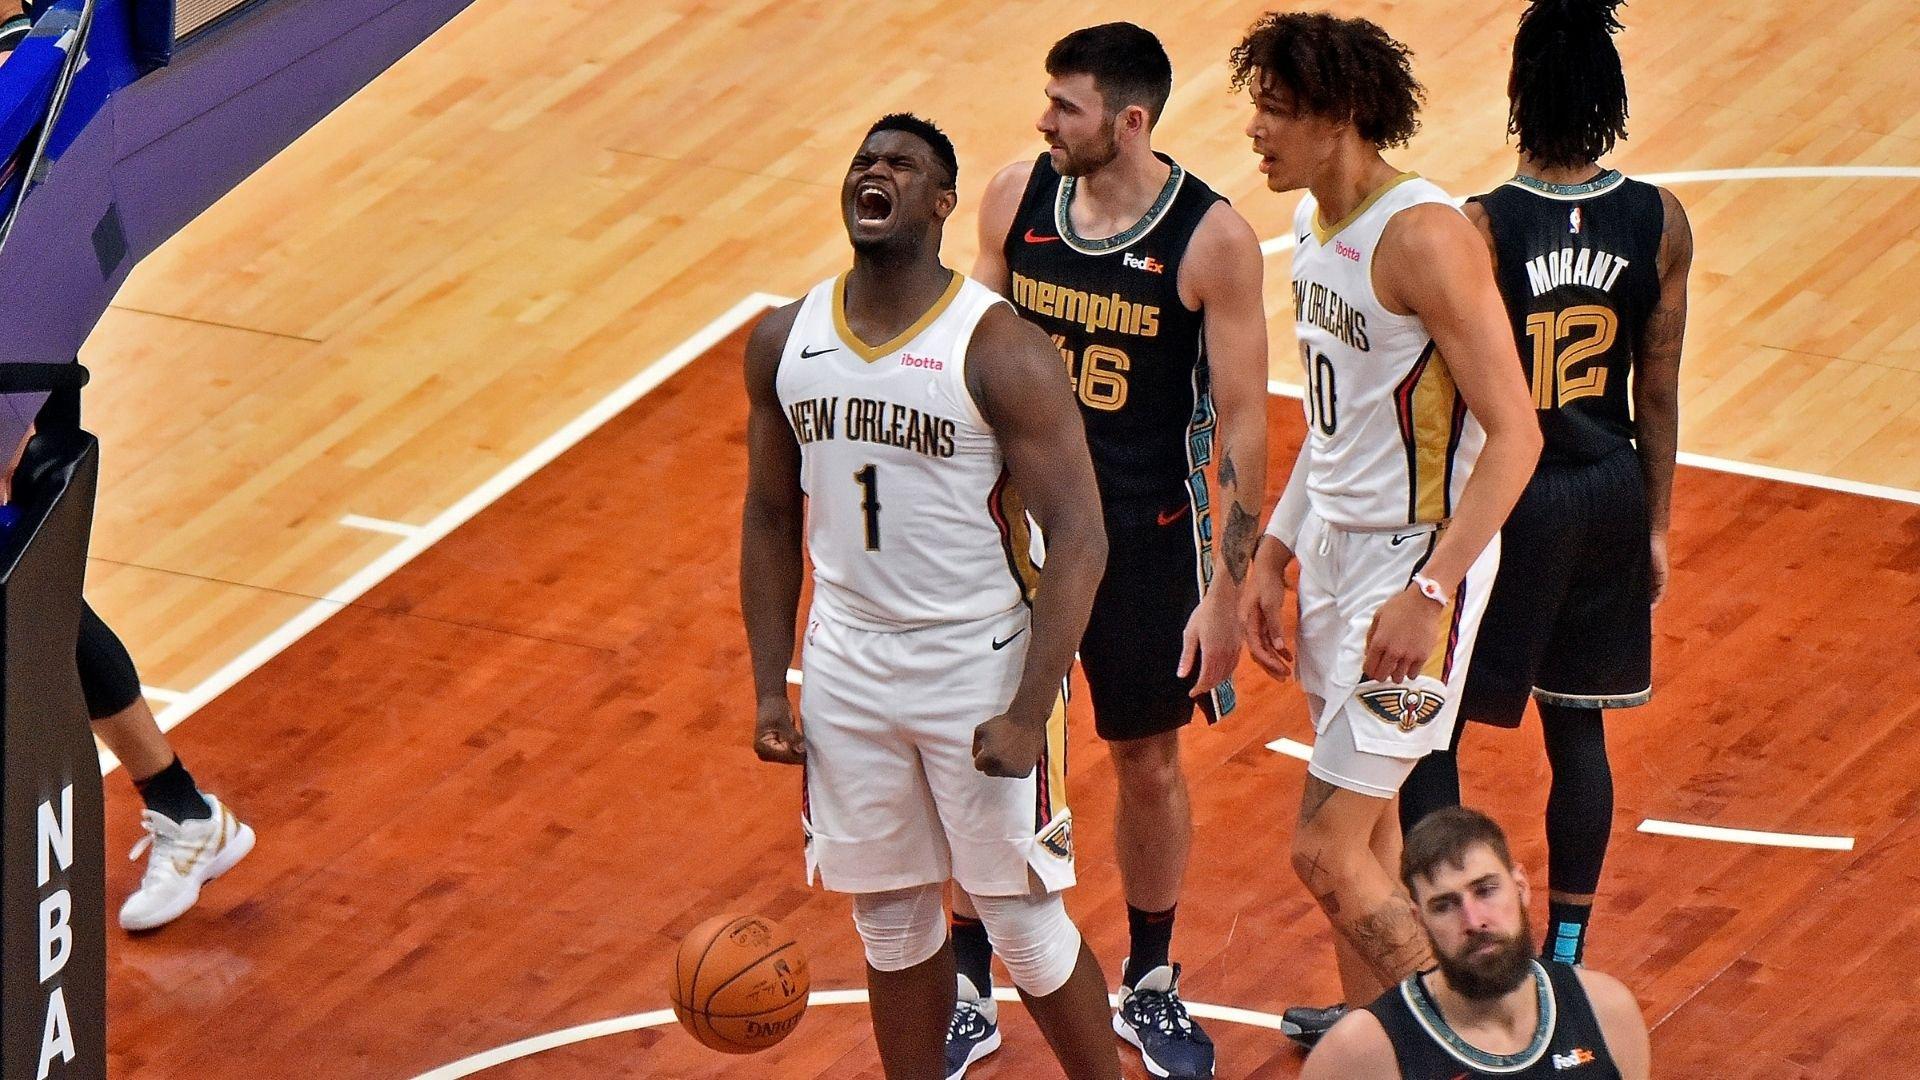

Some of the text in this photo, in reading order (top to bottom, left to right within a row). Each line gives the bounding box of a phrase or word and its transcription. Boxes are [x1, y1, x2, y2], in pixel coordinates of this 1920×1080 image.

[1122, 252, 1164, 275] FedEx
[1335, 240, 1361, 263] ibotta
[1525, 248, 1630, 297] MORANT
[1012, 271, 1161, 337] memphis
[1308, 281, 1371, 352] ORLEANS
[900, 353, 944, 371] ibotta
[1305, 342, 1337, 437] 10
[1525, 304, 1619, 410] 12
[789, 396, 956, 458] NEW ORLEANS
[853, 463, 881, 553] 1
[36, 783, 76, 1080] NBA
